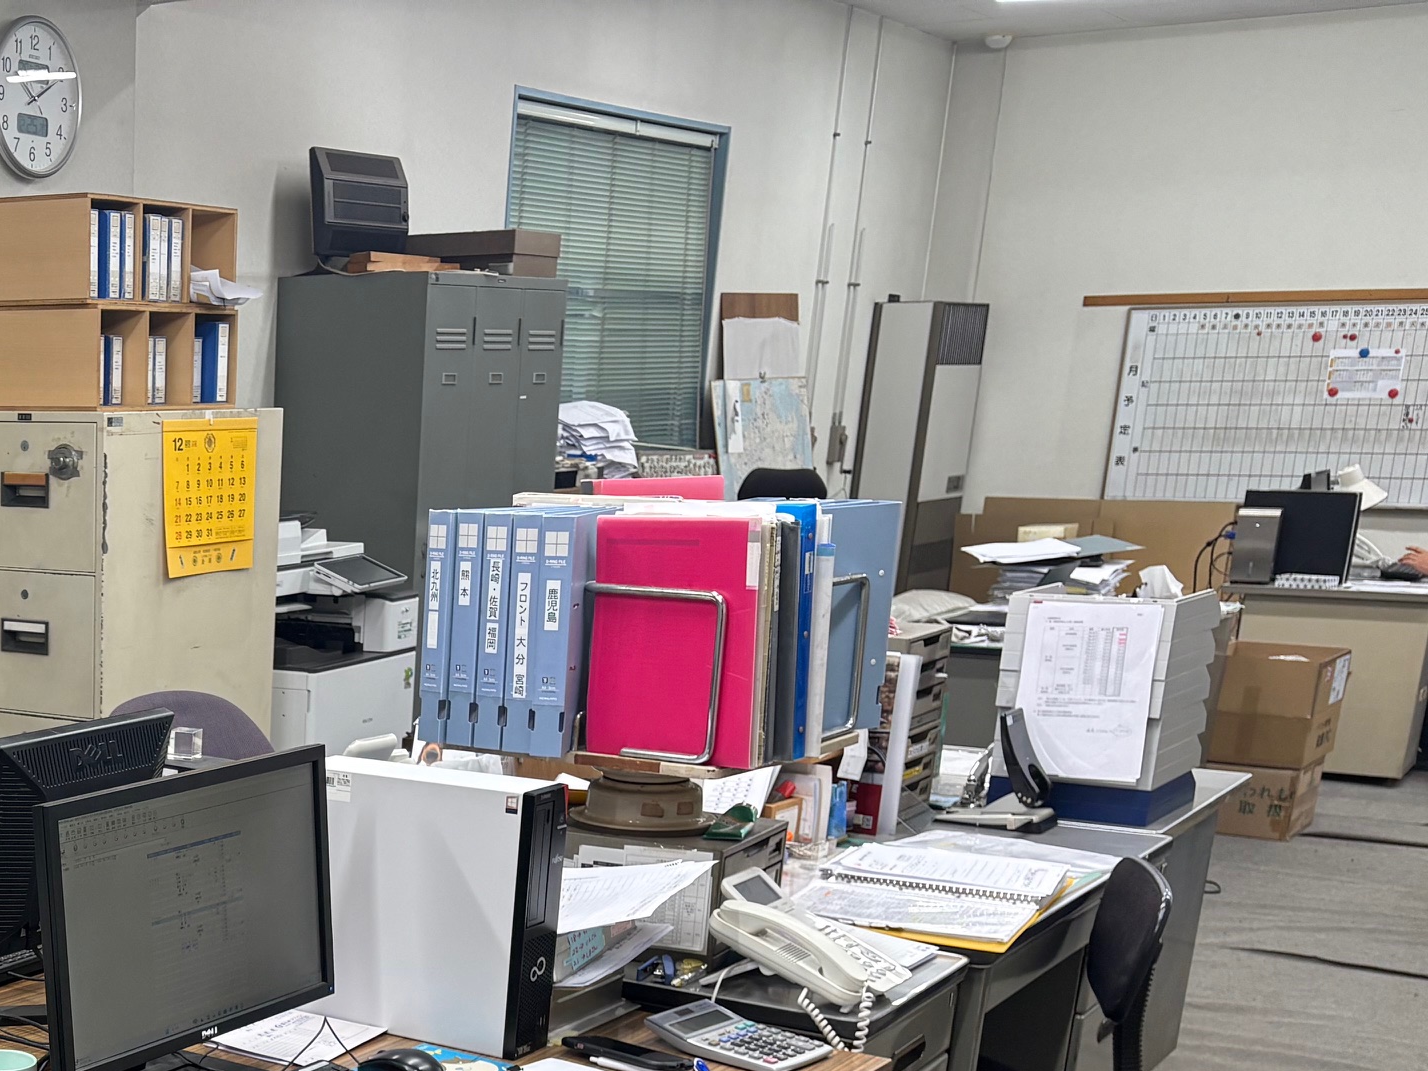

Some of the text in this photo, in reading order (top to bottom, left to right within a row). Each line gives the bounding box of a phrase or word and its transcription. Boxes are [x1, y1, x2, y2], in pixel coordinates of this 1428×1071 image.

[15, 38, 22, 55] 11
[29, 35, 40, 51] 12
[1, 56, 12, 73] 10
[61, 97, 68, 113] 3
[2, 115, 9, 130] 8
[56, 124, 62, 140] 4
[13, 137, 20, 152] 7
[45, 142, 52, 157] 5
[29, 146, 36, 162] 6
[1172, 313, 1177, 321] 2
[1182, 313, 1187, 321] 3
[1266, 311, 1272, 319] 11
[1276, 311, 1283, 319] 12
[1309, 310, 1316, 318] 15
[1320, 310, 1327, 318] 16
[1353, 309, 1360, 317] 19
[1363, 309, 1373, 317] 20
[1397, 308, 1406, 316] 23
[1408, 308, 1418, 316] 24
[173, 437, 184, 451] 12
[185, 460, 245, 472] 1 2 3 4 5 6
[175, 476, 246, 490] 7 8 9 10 11 12 13
[174, 492, 246, 506] 14 15 16 17 18 19 20
[174, 508, 246, 524] 21 22 23 24 25 26 27
[175, 531, 182, 540] 28
[185, 530, 192, 540] 29
[195, 529, 203, 538] 30
[205, 528, 213, 538] 31
[430, 568, 439, 602] 北九州
[460, 569, 470, 598] 熊本
[488, 561, 501, 619] 長崎・佐賀
[546, 588, 559, 624] 鹿児島
[486, 627, 497, 650] 福岡
[513, 582, 529, 697] フロント 大分 宮崎
[70, 740, 123, 766] DELL
[201, 1026, 218, 1039] DELL
